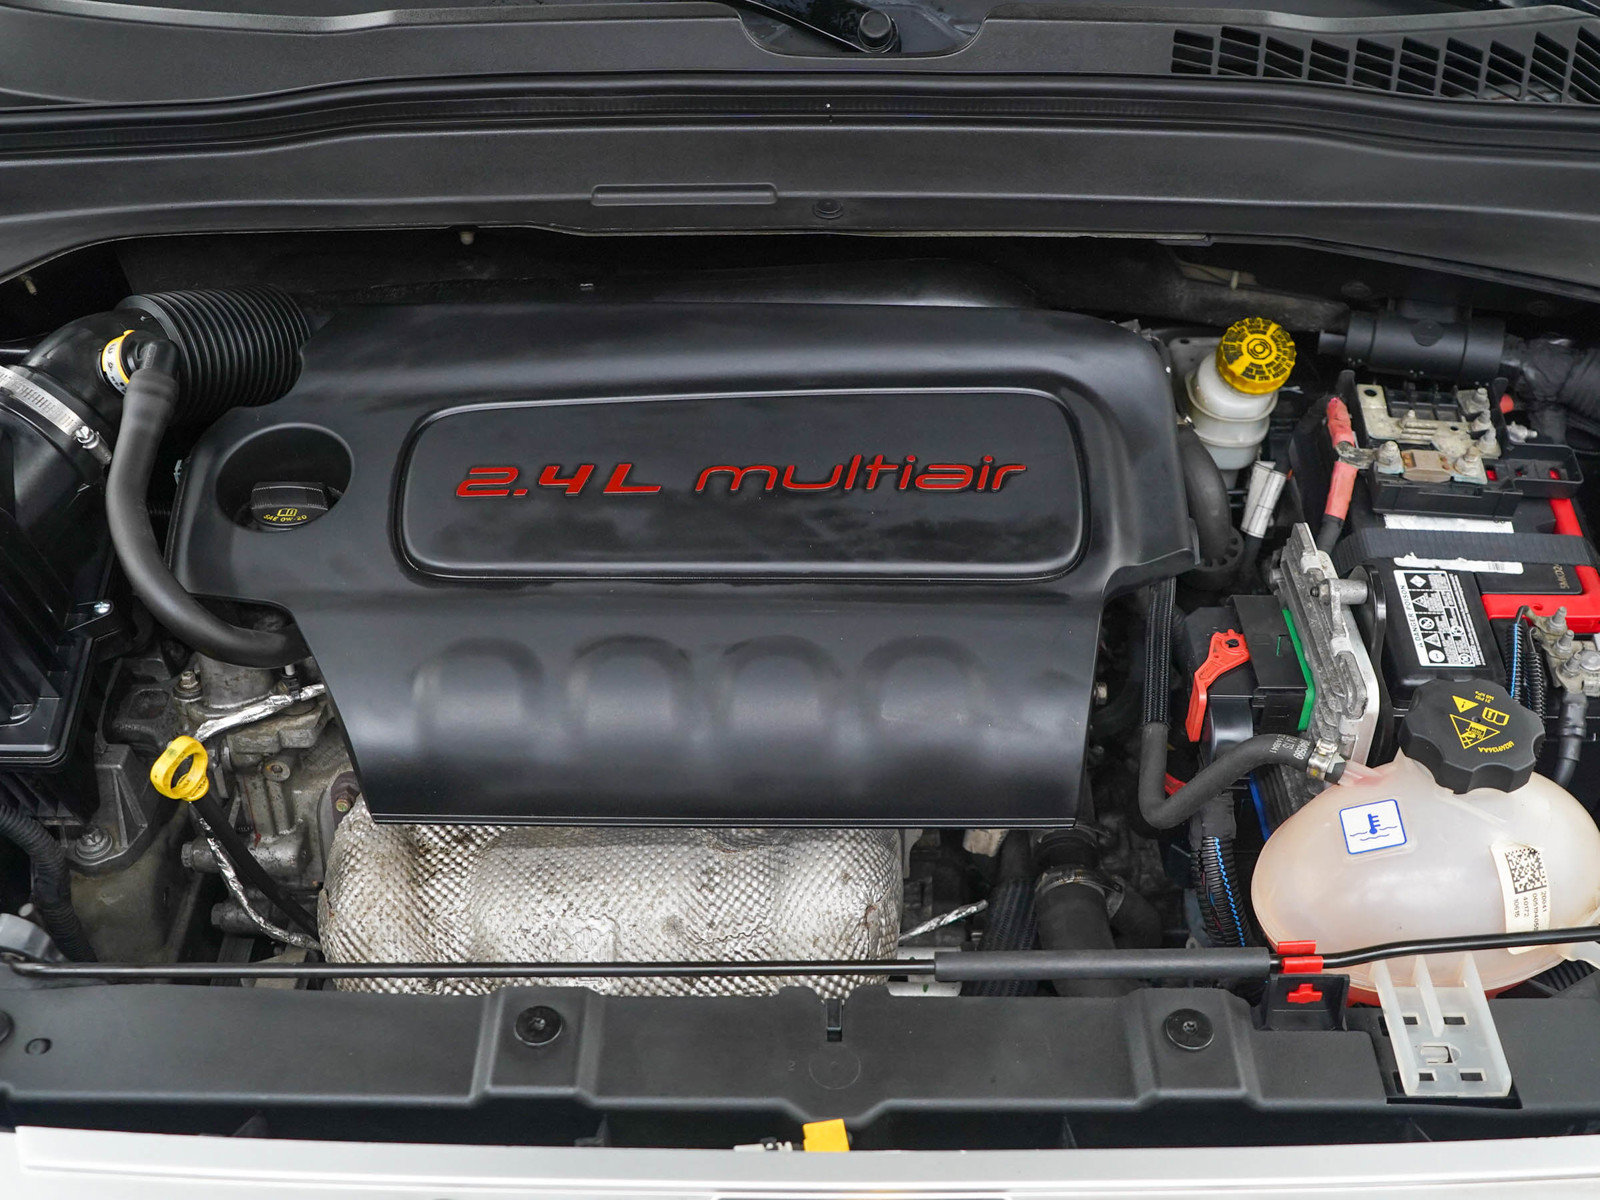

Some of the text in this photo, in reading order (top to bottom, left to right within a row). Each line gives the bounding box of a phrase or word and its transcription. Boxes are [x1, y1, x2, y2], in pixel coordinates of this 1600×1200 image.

[694, 454, 1027, 492] multiair
[263, 514, 279, 522] SAE
[1401, 585, 1421, 641] DANGER POISON
